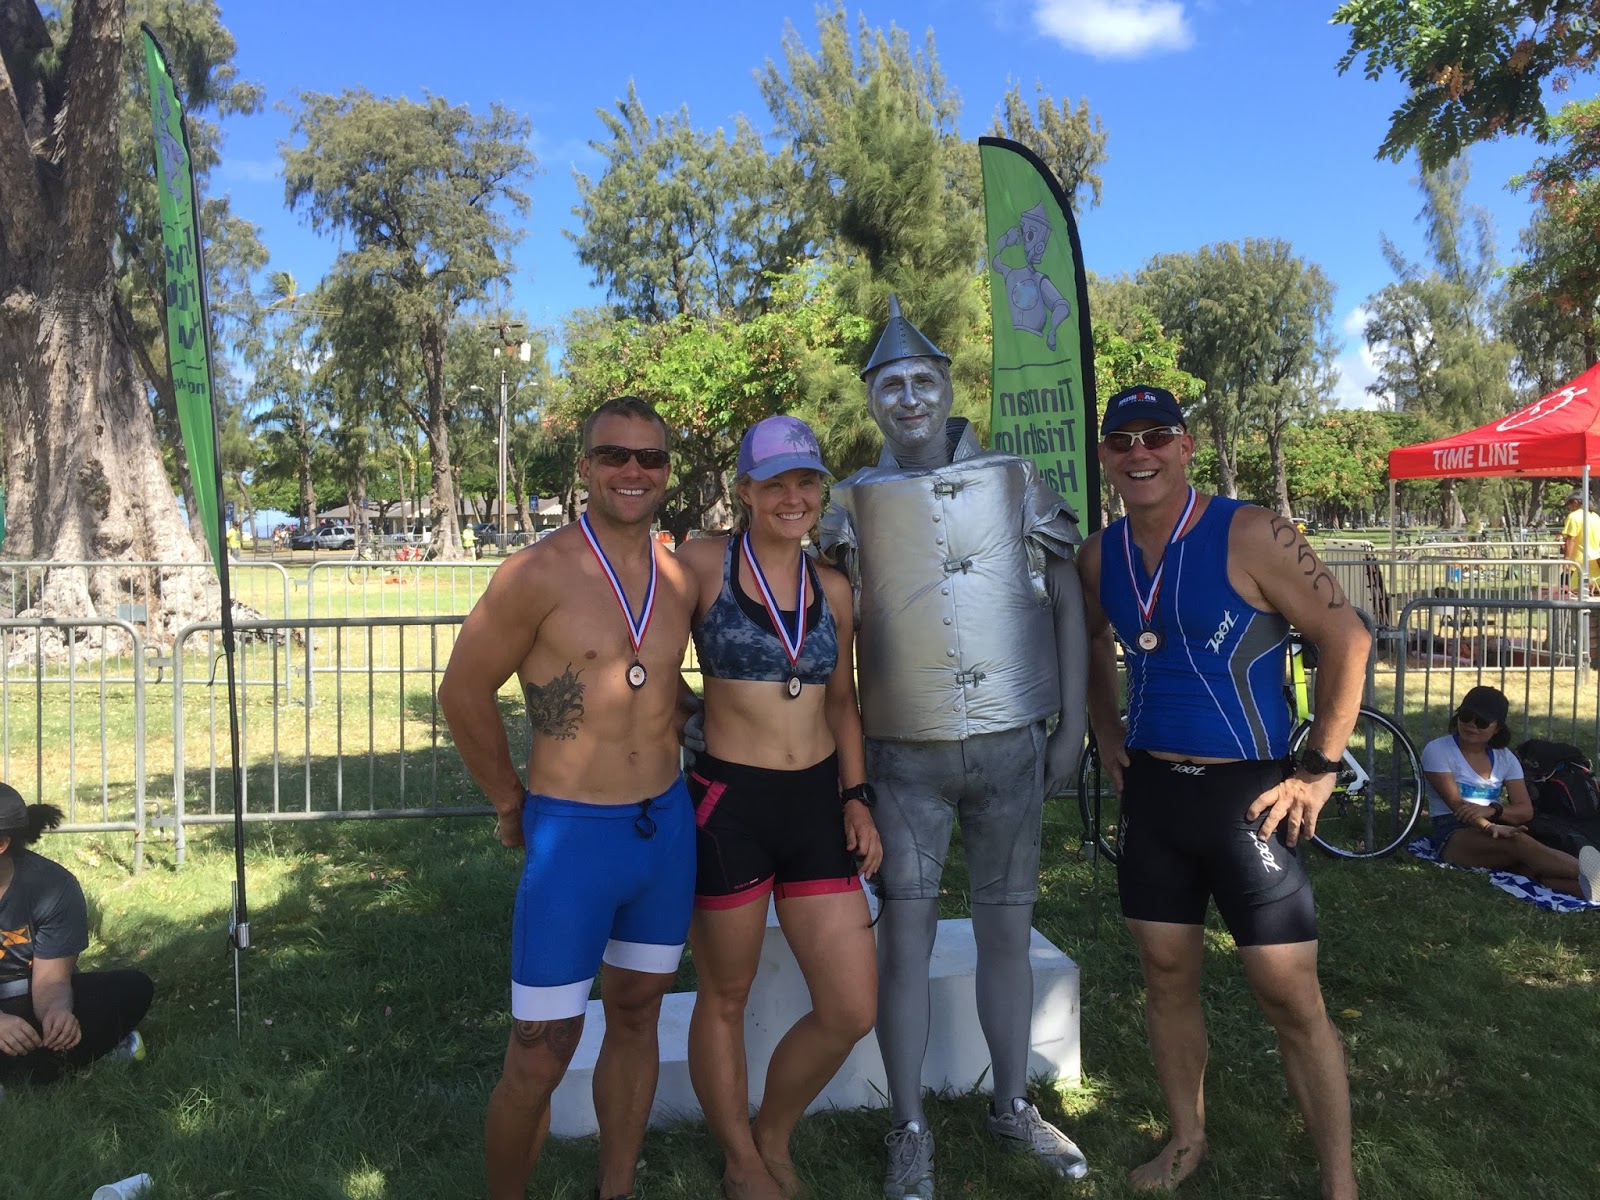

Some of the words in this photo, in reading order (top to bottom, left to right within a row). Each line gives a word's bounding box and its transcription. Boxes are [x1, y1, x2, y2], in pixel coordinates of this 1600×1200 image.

[1433, 445, 1475, 470] TIME
[1478, 442, 1521, 468] LINE
[1270, 514, 1345, 609] 552
